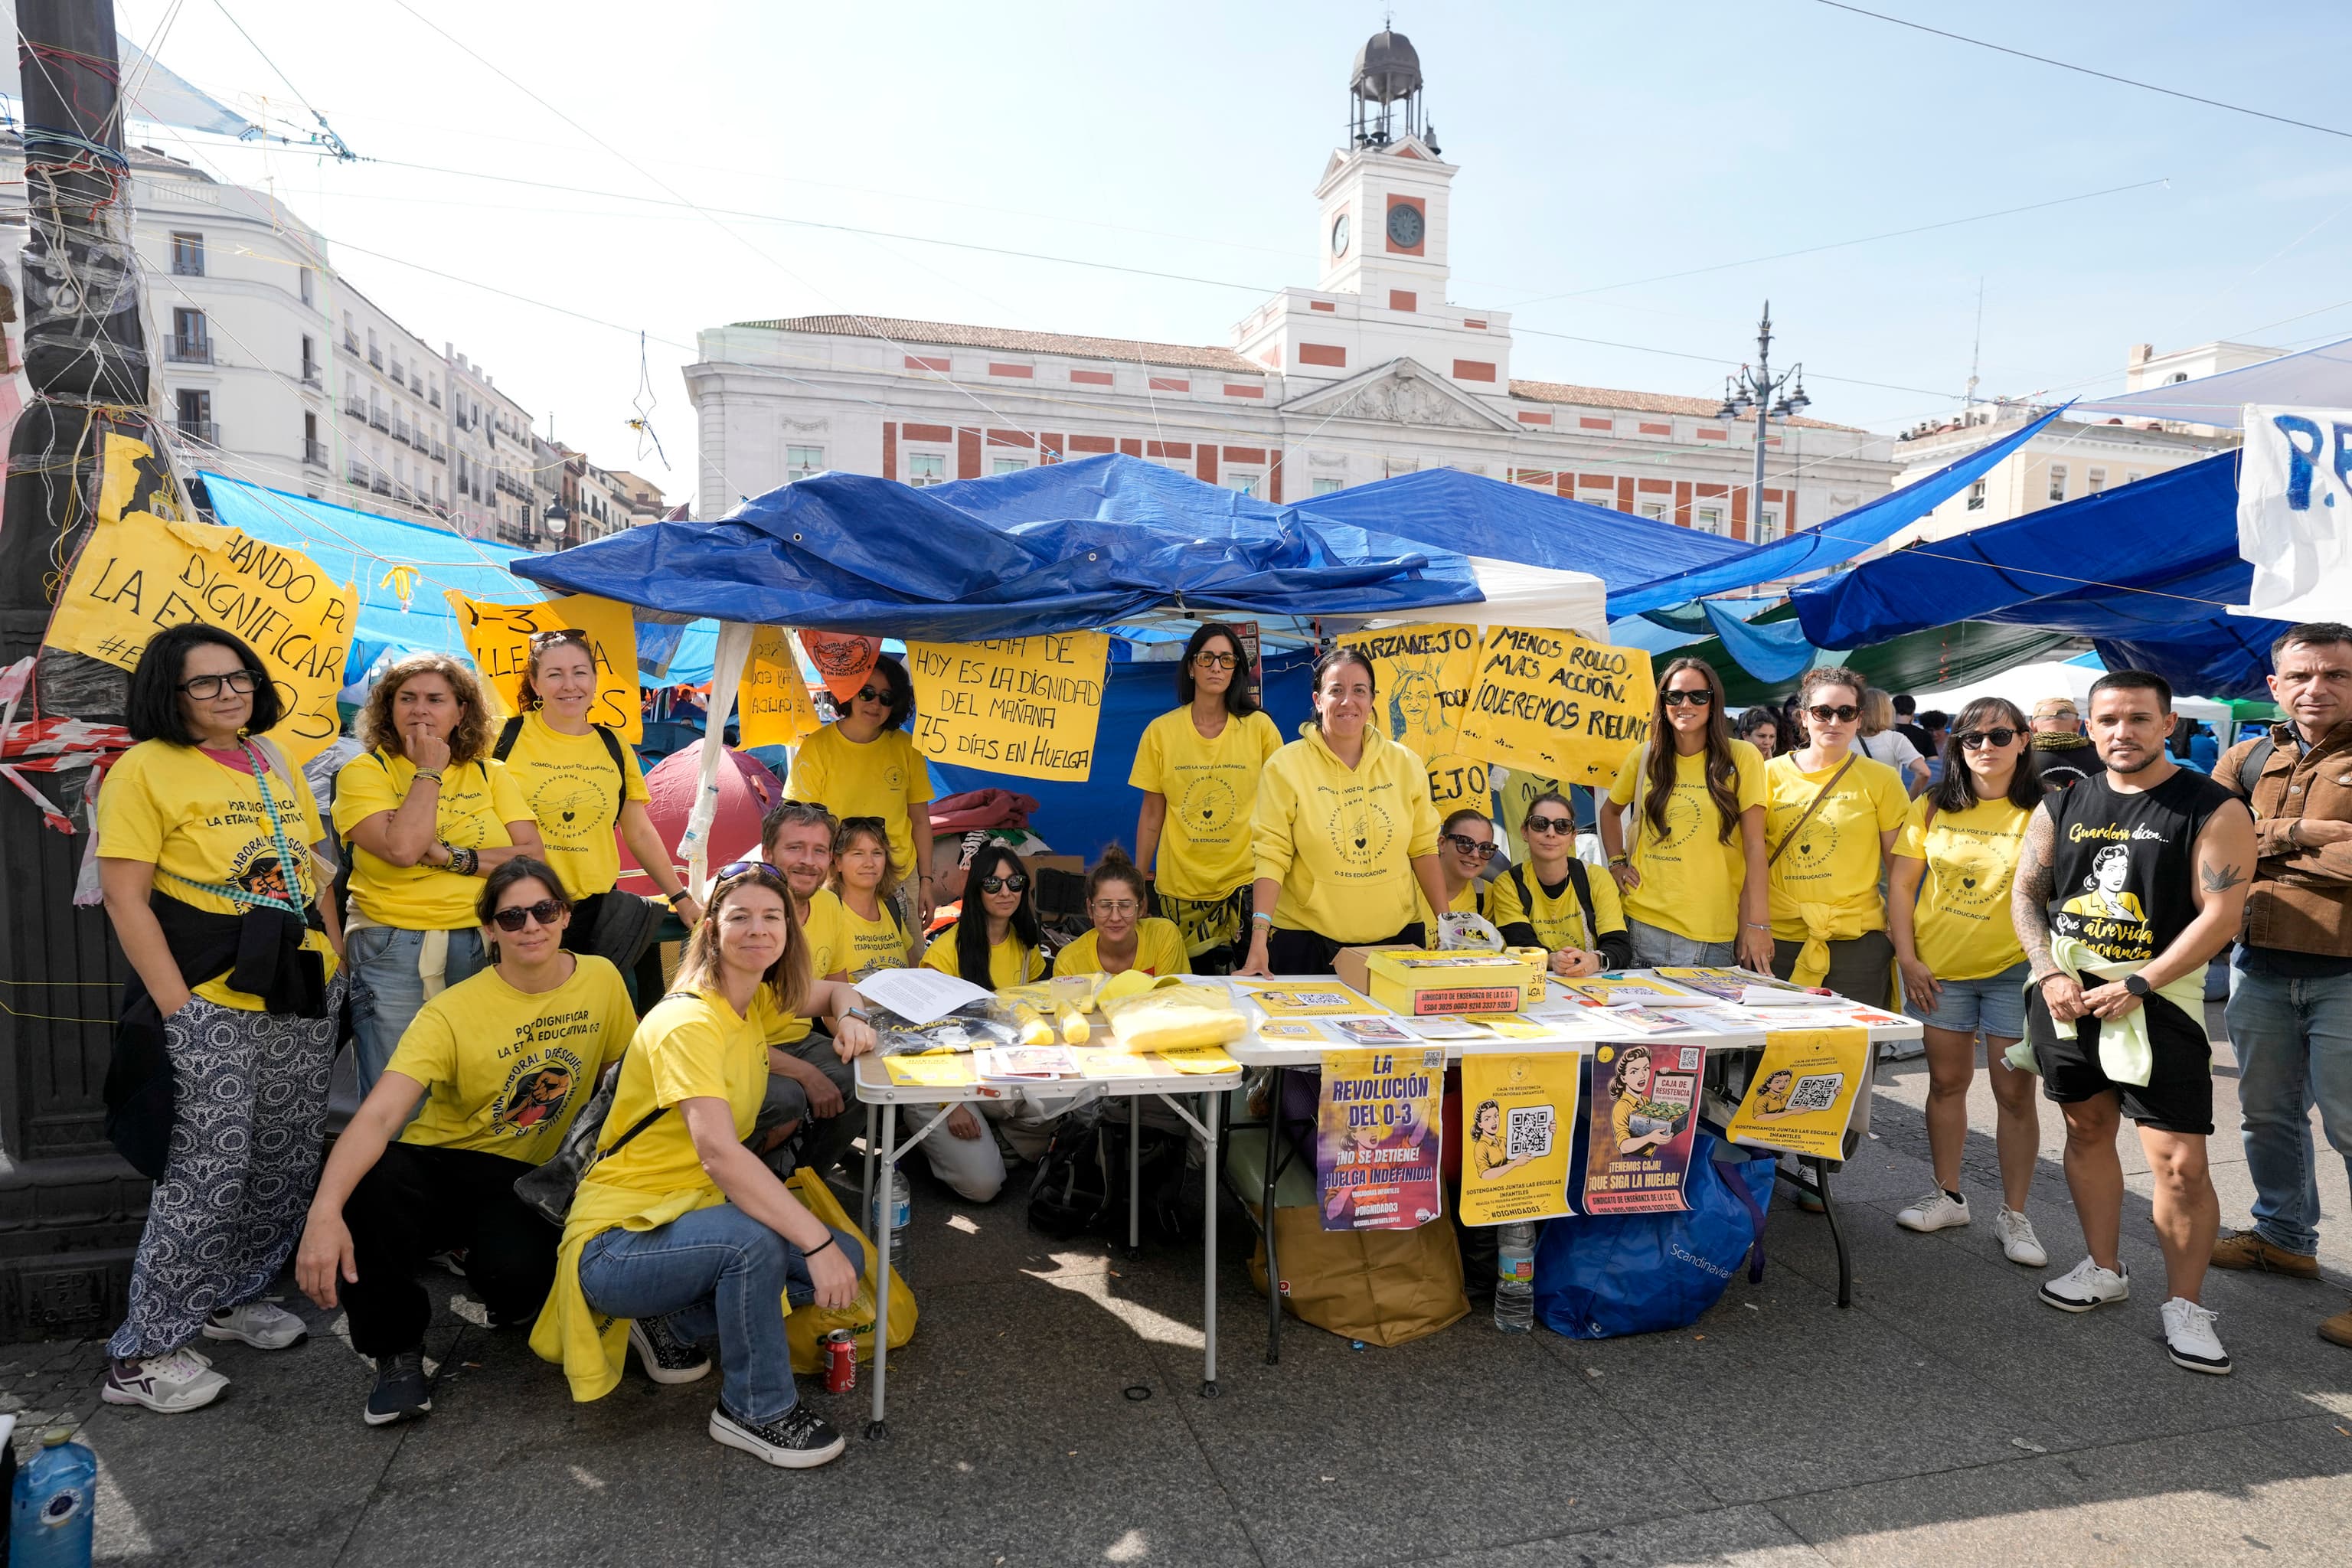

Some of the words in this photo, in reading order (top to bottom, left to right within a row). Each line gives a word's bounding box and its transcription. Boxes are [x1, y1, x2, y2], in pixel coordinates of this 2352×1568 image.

[90, 557, 144, 616] LA
[179, 553, 344, 681] DIGNIFICAR
[1045, 635, 1075, 664] DE
[1490, 627, 1563, 658] MENOS
[916, 648, 952, 678] HOY
[958, 660, 985, 684] ES
[989, 666, 1014, 692] LA
[941, 689, 978, 717] DEL
[989, 697, 1056, 729] MAÑANA
[1472, 678, 1580, 730] ¡QUEREMOS
[919, 713, 949, 754] 75
[957, 733, 999, 760] DÍAS
[1005, 740, 1027, 763] EN
[1031, 735, 1089, 769] HUELGA
[206, 816, 223, 827] LA
[1421, 993, 1448, 1001] SINDICATO
[1456, 991, 1485, 1000] ENSEÑANZA
[497, 1047, 511, 1059] LA
[1373, 1054, 1393, 1075] LA
[1332, 1072, 1429, 1102] REVOLUCIÓN
[1655, 1086, 1690, 1097] RESISTENCIA
[1661, 1079, 1677, 1087] CAJA
[1678, 1080, 1687, 1089] DE
[1349, 1104, 1380, 1127] DEL
[1383, 1102, 1413, 1126] 0-3
[1336, 1150, 1356, 1166] ¡NO
[1358, 1149, 1372, 1164] SE
[1374, 1147, 1420, 1164] DETIENE!
[1609, 1161, 1642, 1174] ¡TENEMOS
[1642, 1160, 1661, 1171] CAJA!
[1325, 1169, 1368, 1190] HUELGA
[1370, 1166, 1433, 1184] INDEFINIDA
[1588, 1175, 1608, 1191] ¡QUE
[1610, 1174, 1630, 1190] SIGA
[1632, 1174, 1644, 1188] LA
[1645, 1172, 1680, 1187] HUELGA!
[1466, 1186, 1504, 1195] SOSTENGAMOS
[1500, 1189, 1529, 1198] INFANTILES
[1592, 1196, 1616, 1205] SINDICATO
[1624, 1193, 1651, 1203] ENSEÑANZA
[1354, 1202, 1399, 1217] #DIGNIDAD03
[1491, 1205, 1540, 1218] #DIGNIDAD03
